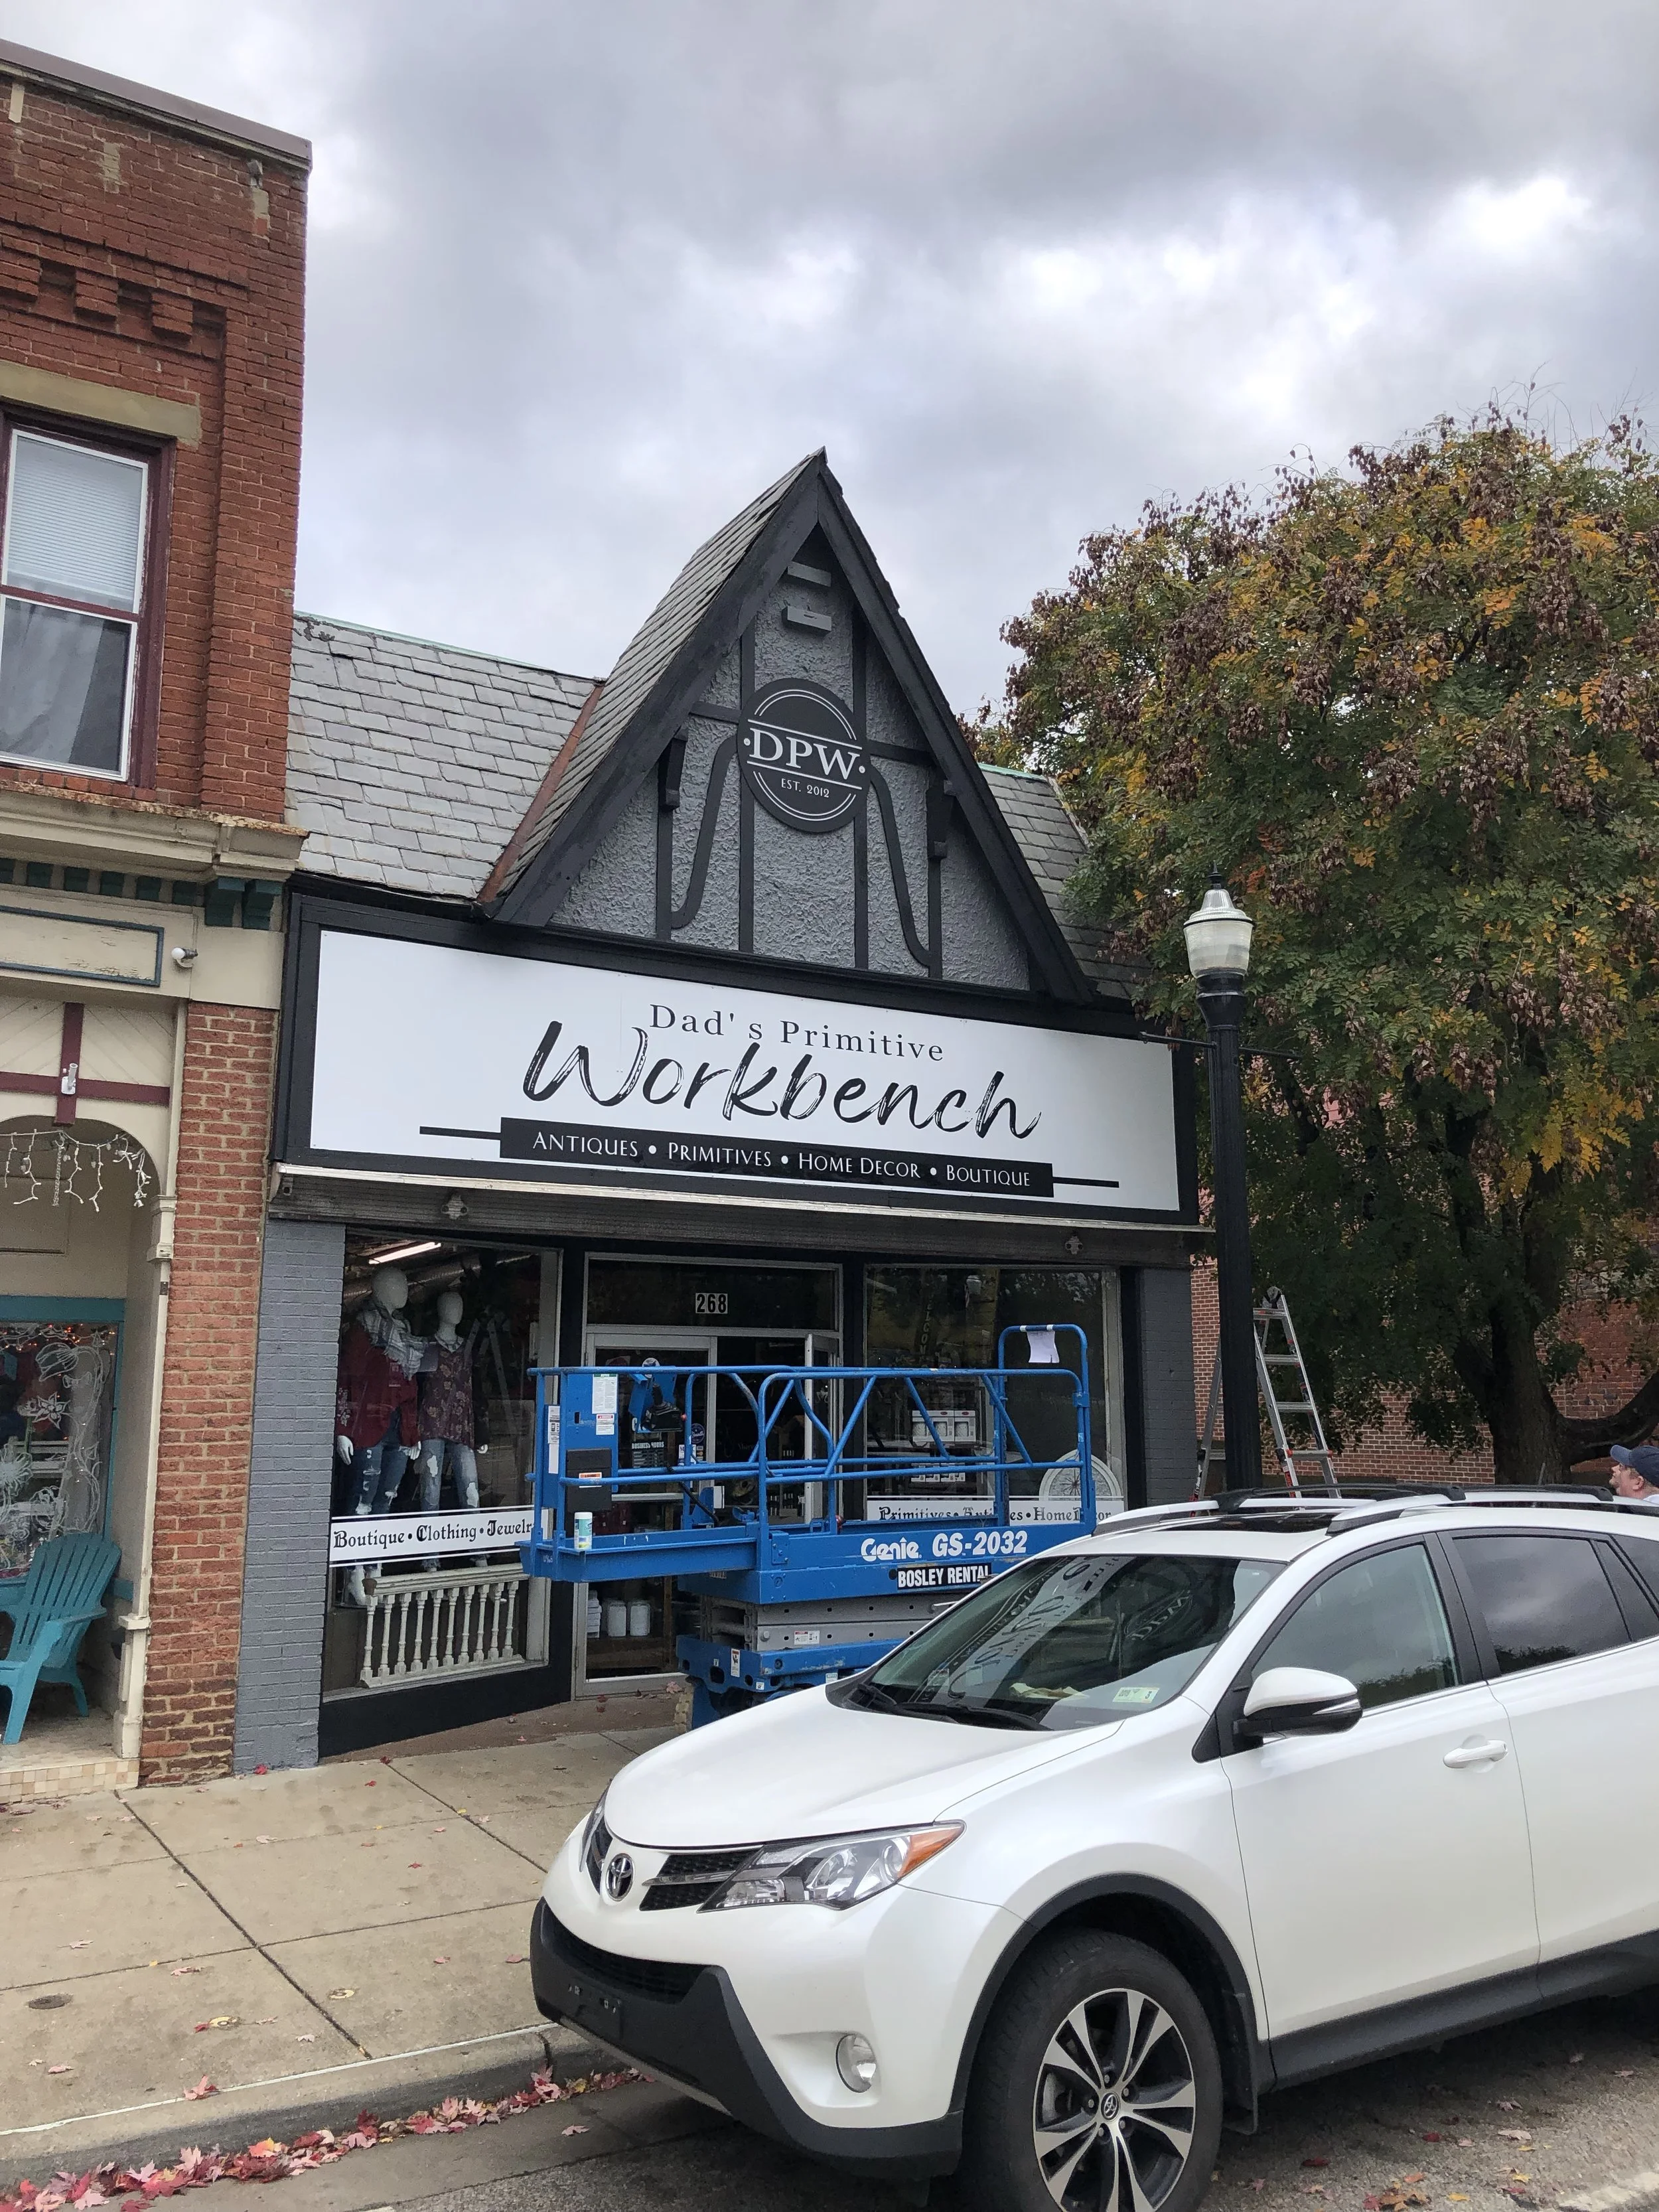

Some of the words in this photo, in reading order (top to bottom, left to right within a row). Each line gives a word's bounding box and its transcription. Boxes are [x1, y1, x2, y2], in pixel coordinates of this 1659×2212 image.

[749, 727, 860, 780] DPW
[780, 778, 802, 792] EST.
[806, 784, 830, 798] 2012
[650, 1004, 762, 1040] Dad's
[780, 1020, 943, 1062] Primitive
[523, 1021, 1042, 1140] Workbench
[798, 1153, 853, 1173] HOME
[860, 1158, 921, 1179] DECOR
[696, 1293, 727, 1313] 268
[1033, 1507, 1074, 1521] Home
[332, 1530, 405, 1550] Boutique
[416, 1523, 477, 1543] Clothing
[486, 1518, 533, 1537] Jewelr
[860, 1536, 920, 1562] Genie
[932, 1530, 1029, 1558] GS-2032
[898, 1568, 944, 1588] BOSLEY
